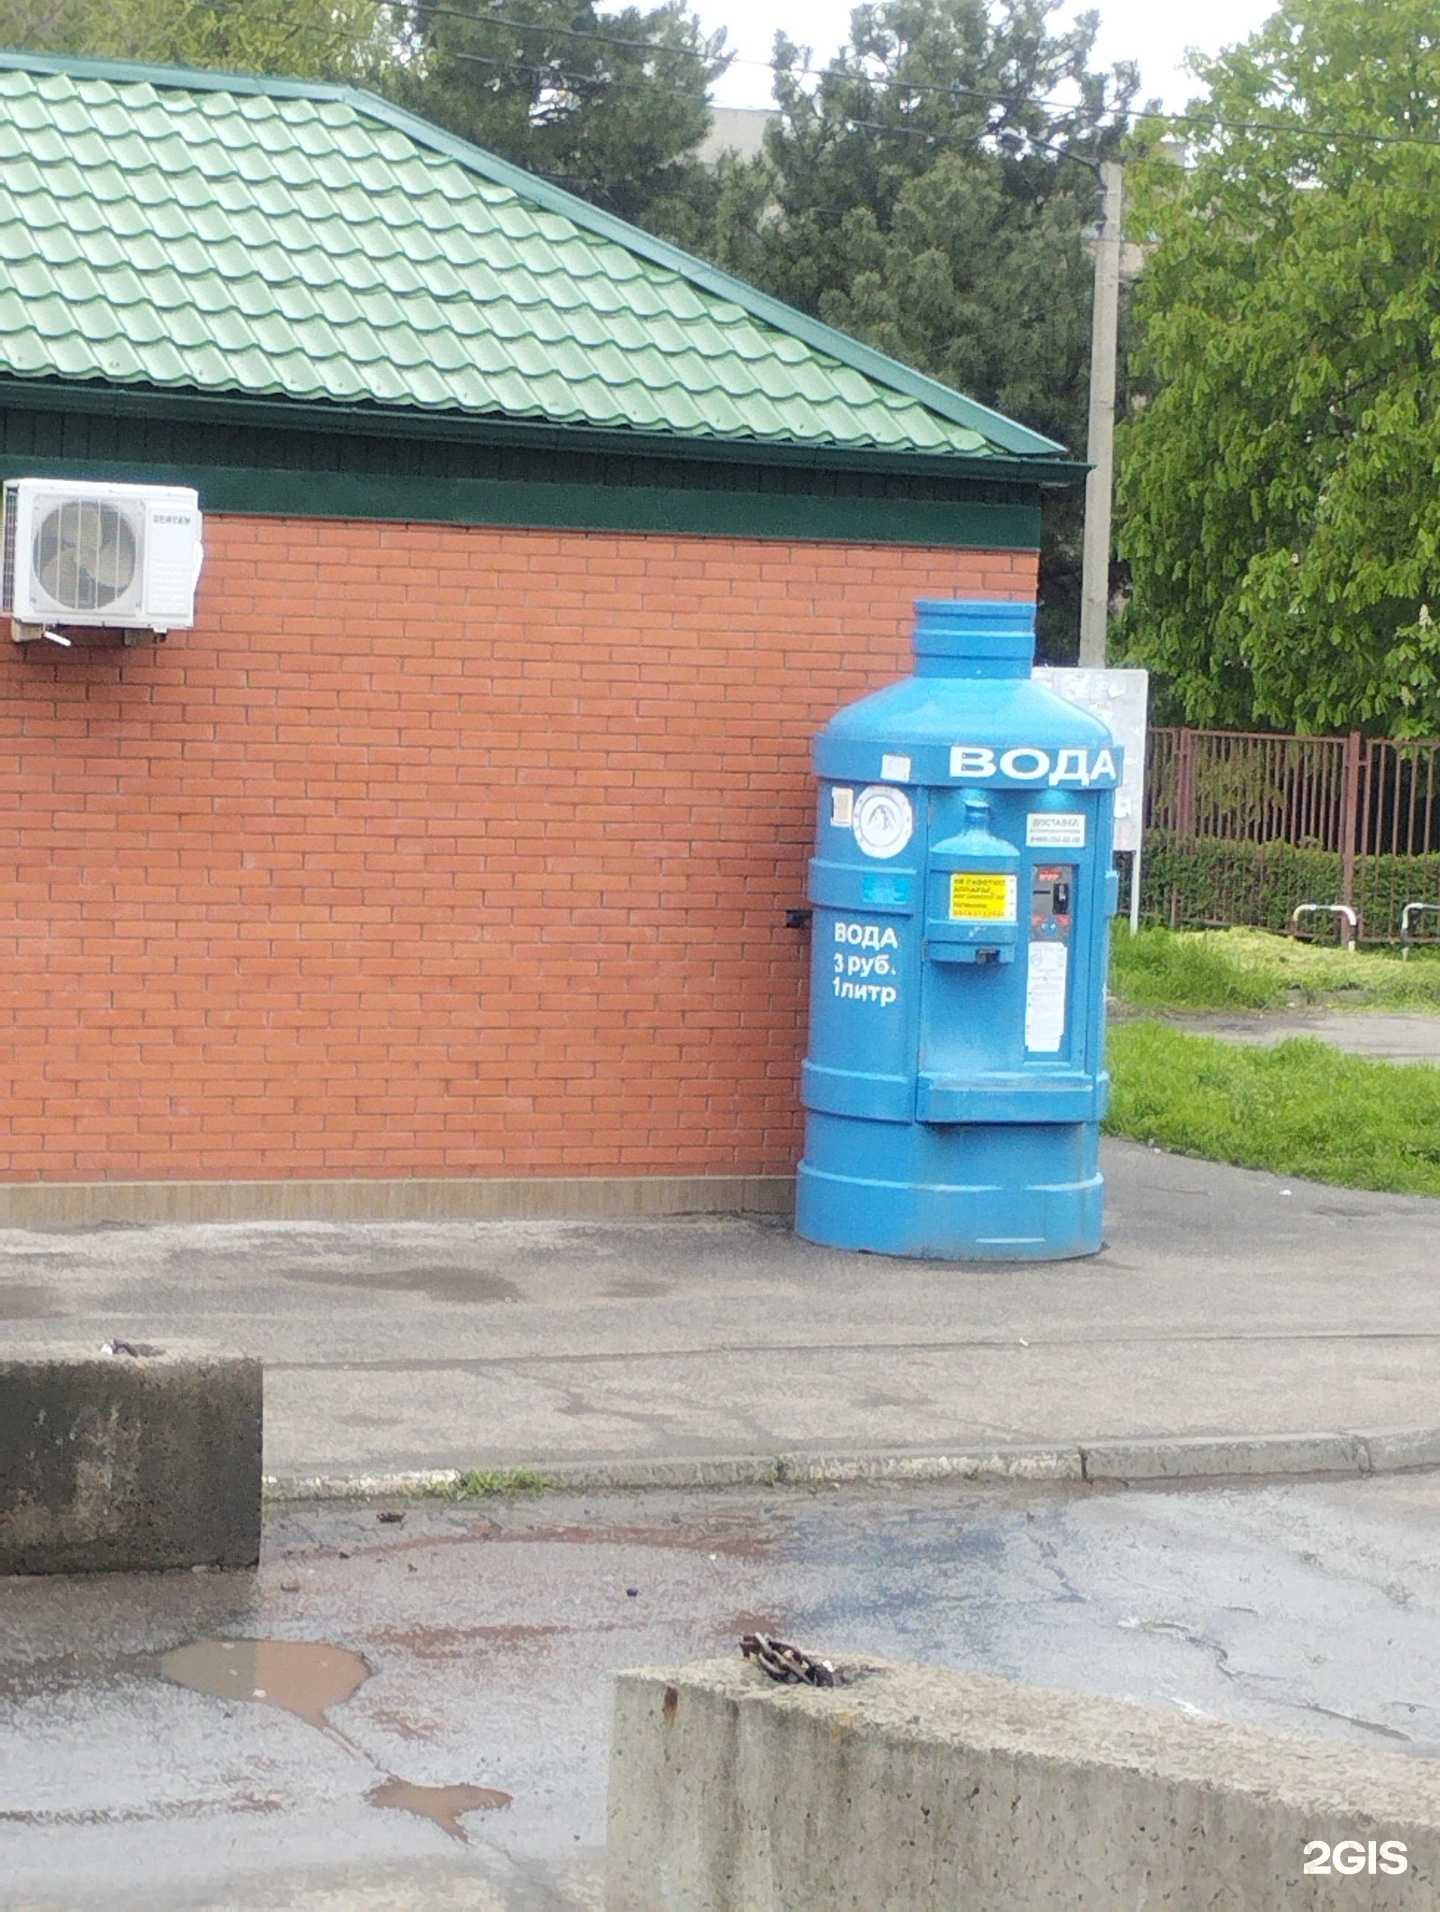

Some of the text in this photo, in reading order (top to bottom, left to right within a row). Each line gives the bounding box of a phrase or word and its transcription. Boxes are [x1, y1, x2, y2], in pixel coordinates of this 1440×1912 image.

[949, 745, 1117, 787] ВОДА
[834, 921, 898, 951] ВОДА
[833, 952, 897, 977] 3 руб.
